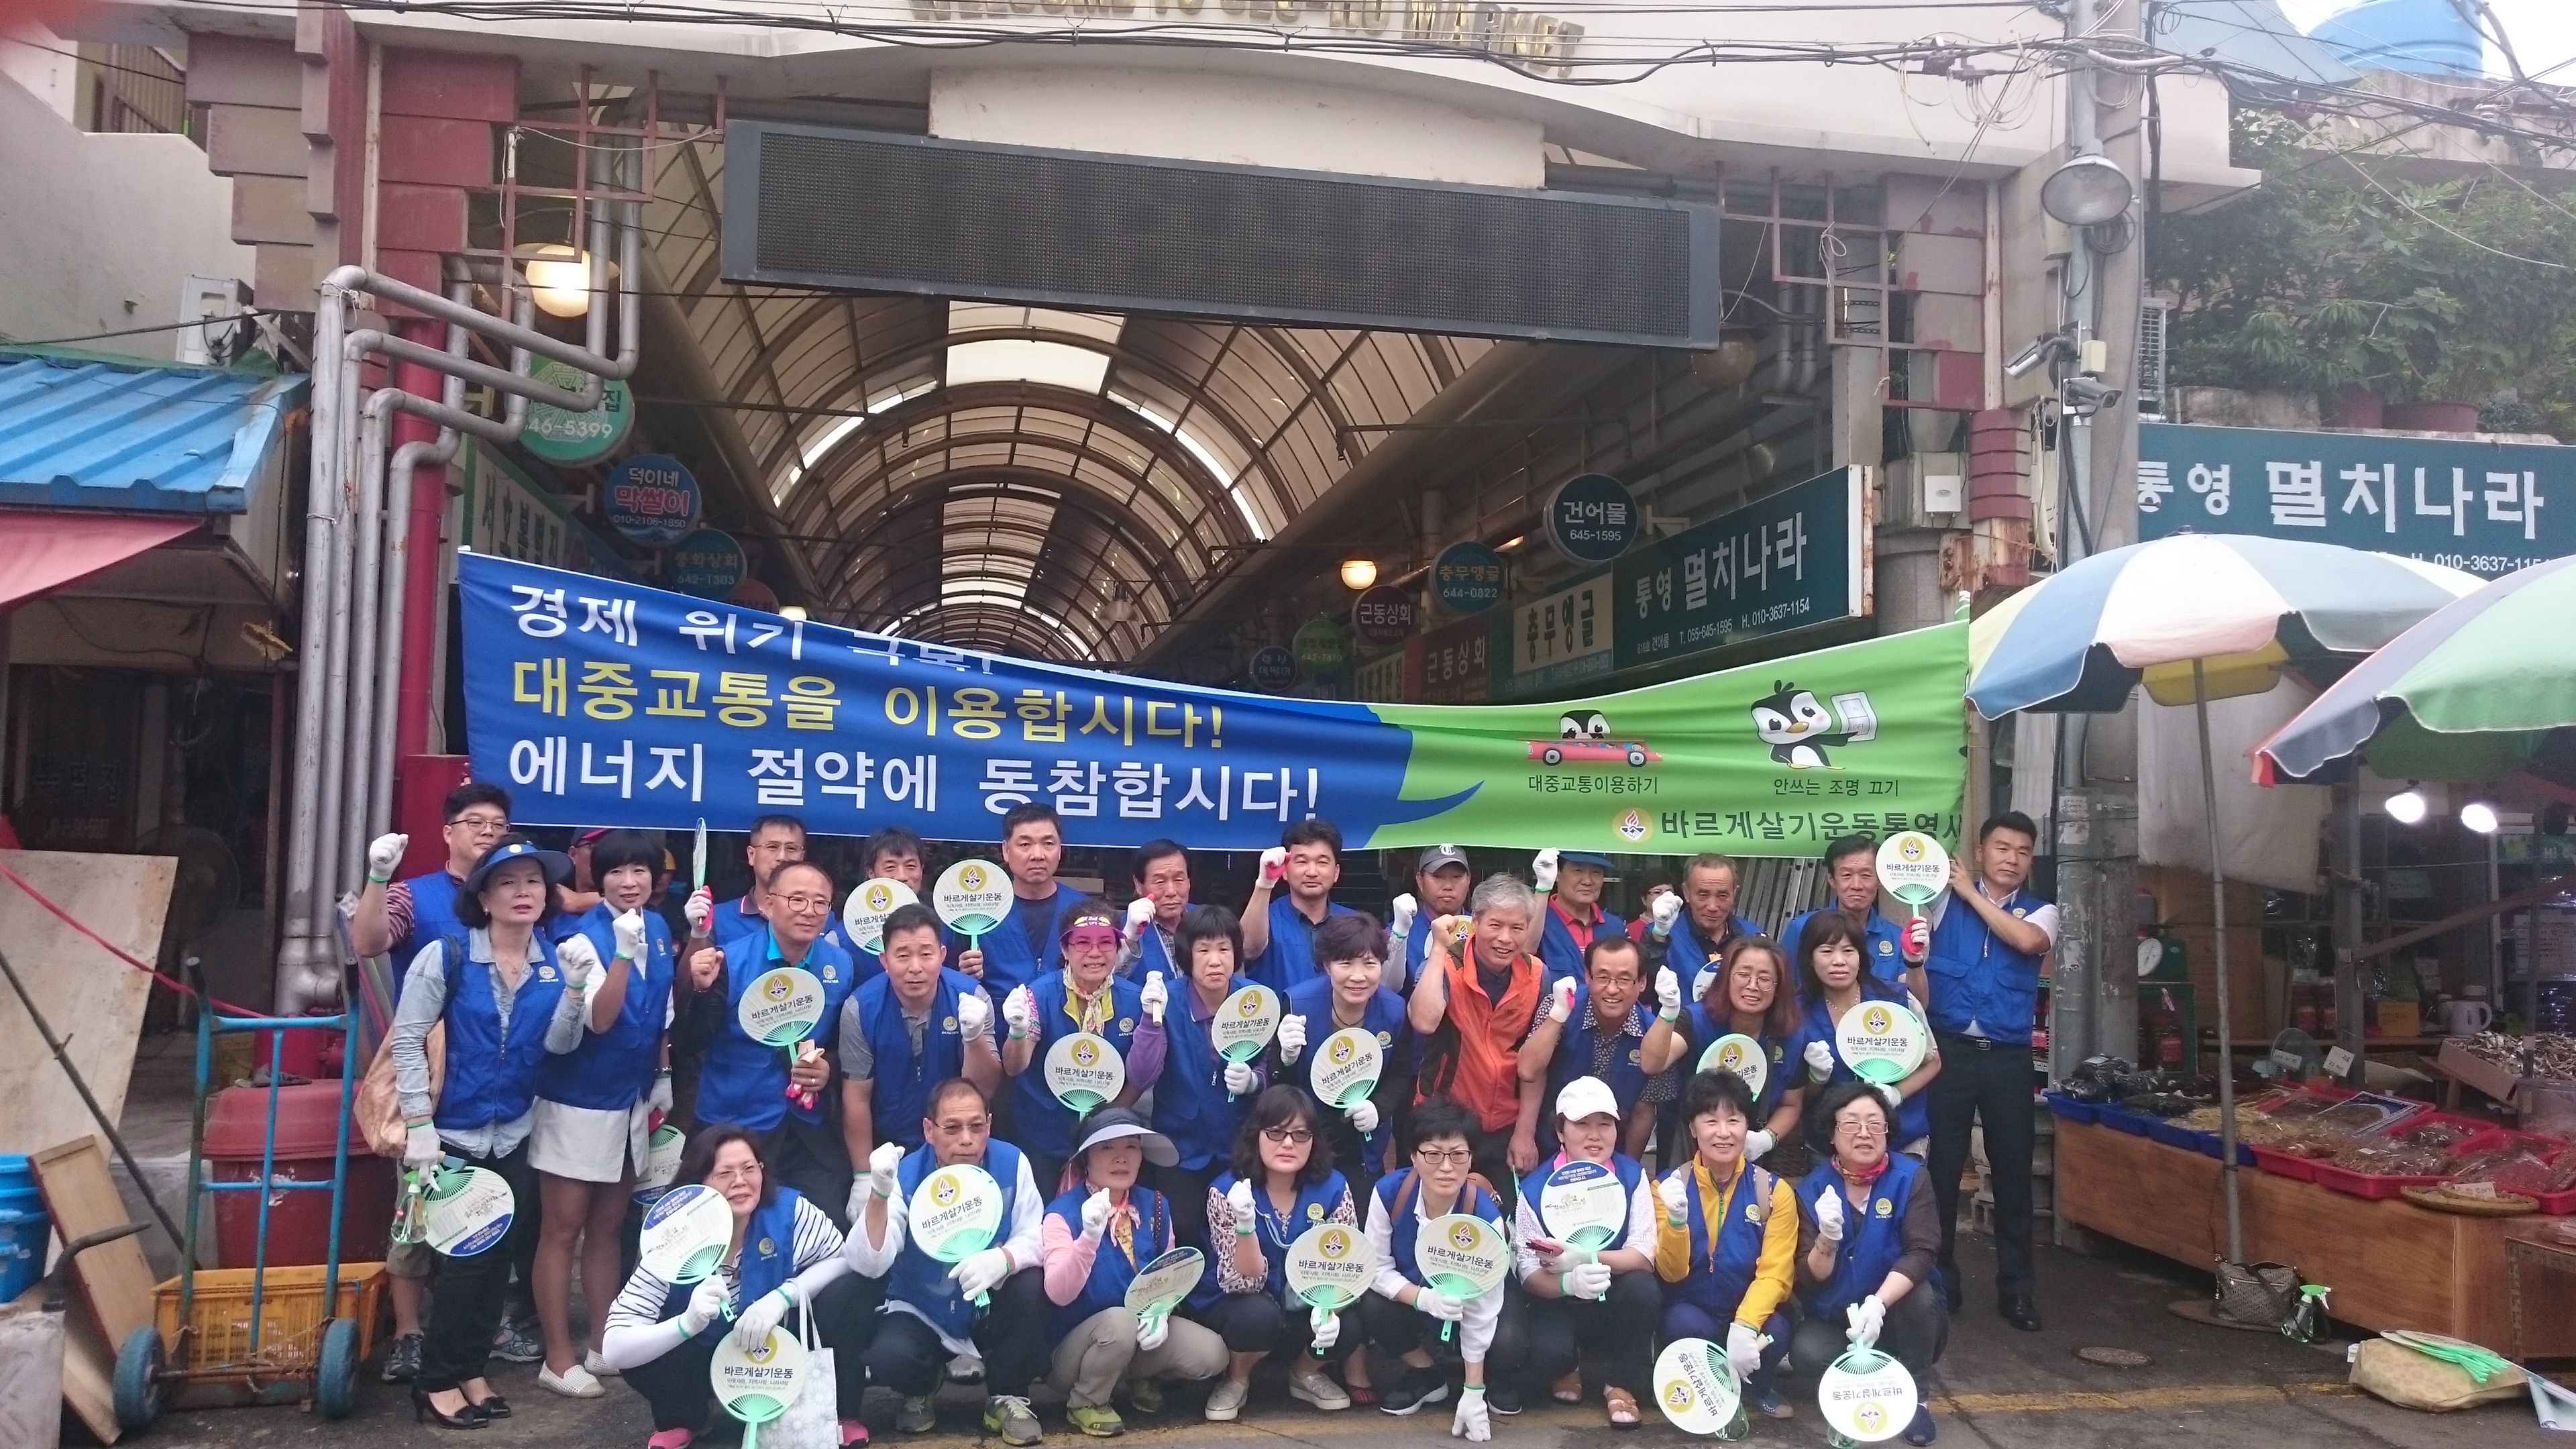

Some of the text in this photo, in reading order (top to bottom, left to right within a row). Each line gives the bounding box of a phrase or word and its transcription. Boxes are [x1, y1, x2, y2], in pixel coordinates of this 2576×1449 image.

[1402, 3, 1586, 78] MARKET
[525, 417, 612, 439] 46-5399
[629, 467, 680, 487] 덕이네
[614, 485, 690, 517] 막썰이
[2137, 460, 2544, 539] 통영 멸치나라
[1563, 501, 1627, 525] 건어물
[1570, 529, 1621, 541] 645-1595
[1635, 511, 1809, 621] 통영 멸치나라
[2434, 553, 2551, 571] 010-3637-11
[1439, 565, 1500, 582] 충무앵글
[1443, 588, 1498, 598] 644-0822
[511, 584, 639, 647] 경제
[678, 610, 804, 660] 위기
[1360, 603, 1411, 626] 근동상회
[1652, 633, 1670, 651] 건어물
[1687, 619, 1733, 643] 055-645-1595
[1741, 614, 1750, 629] H.
[1752, 597, 1810, 626] 010-3637-1154
[1526, 589, 1595, 663] 충무앵글
[1427, 635, 1486, 684] 근동상회
[514, 657, 1223, 749] 대중교통을 이용합시다!
[509, 735, 1320, 822] 에너지 절약에 동참합시다!
[1528, 774, 1659, 794] 대중교통이용하기
[1774, 777, 1900, 797] 안쓰는 조명 끄기
[1886, 863, 1940, 873] 바르게살기운동
[943, 892, 1002, 903] 바르게살기운동
[854, 912, 894, 926] 바르게살
[751, 994, 814, 1020] 바르게살기운동
[1221, 1017, 1271, 1030] 바르게살기운동
[1847, 1036, 1909, 1047] 바르게살기운동
[1055, 1065, 1114, 1081] 바르게살기운동
[1321, 1052, 1373, 1085] 바르게살기운동
[921, 1195, 983, 1230] 바르게살기운동
[1298, 1258, 1365, 1273] 바르게살기운동
[1427, 1245, 1494, 1270] 바르게살기운동
[724, 1365, 794, 1379] 바르게살기운동
[1678, 1351, 1719, 1417] 바르게살기운동
[1831, 1387, 1904, 1401] 바르게살기운동
